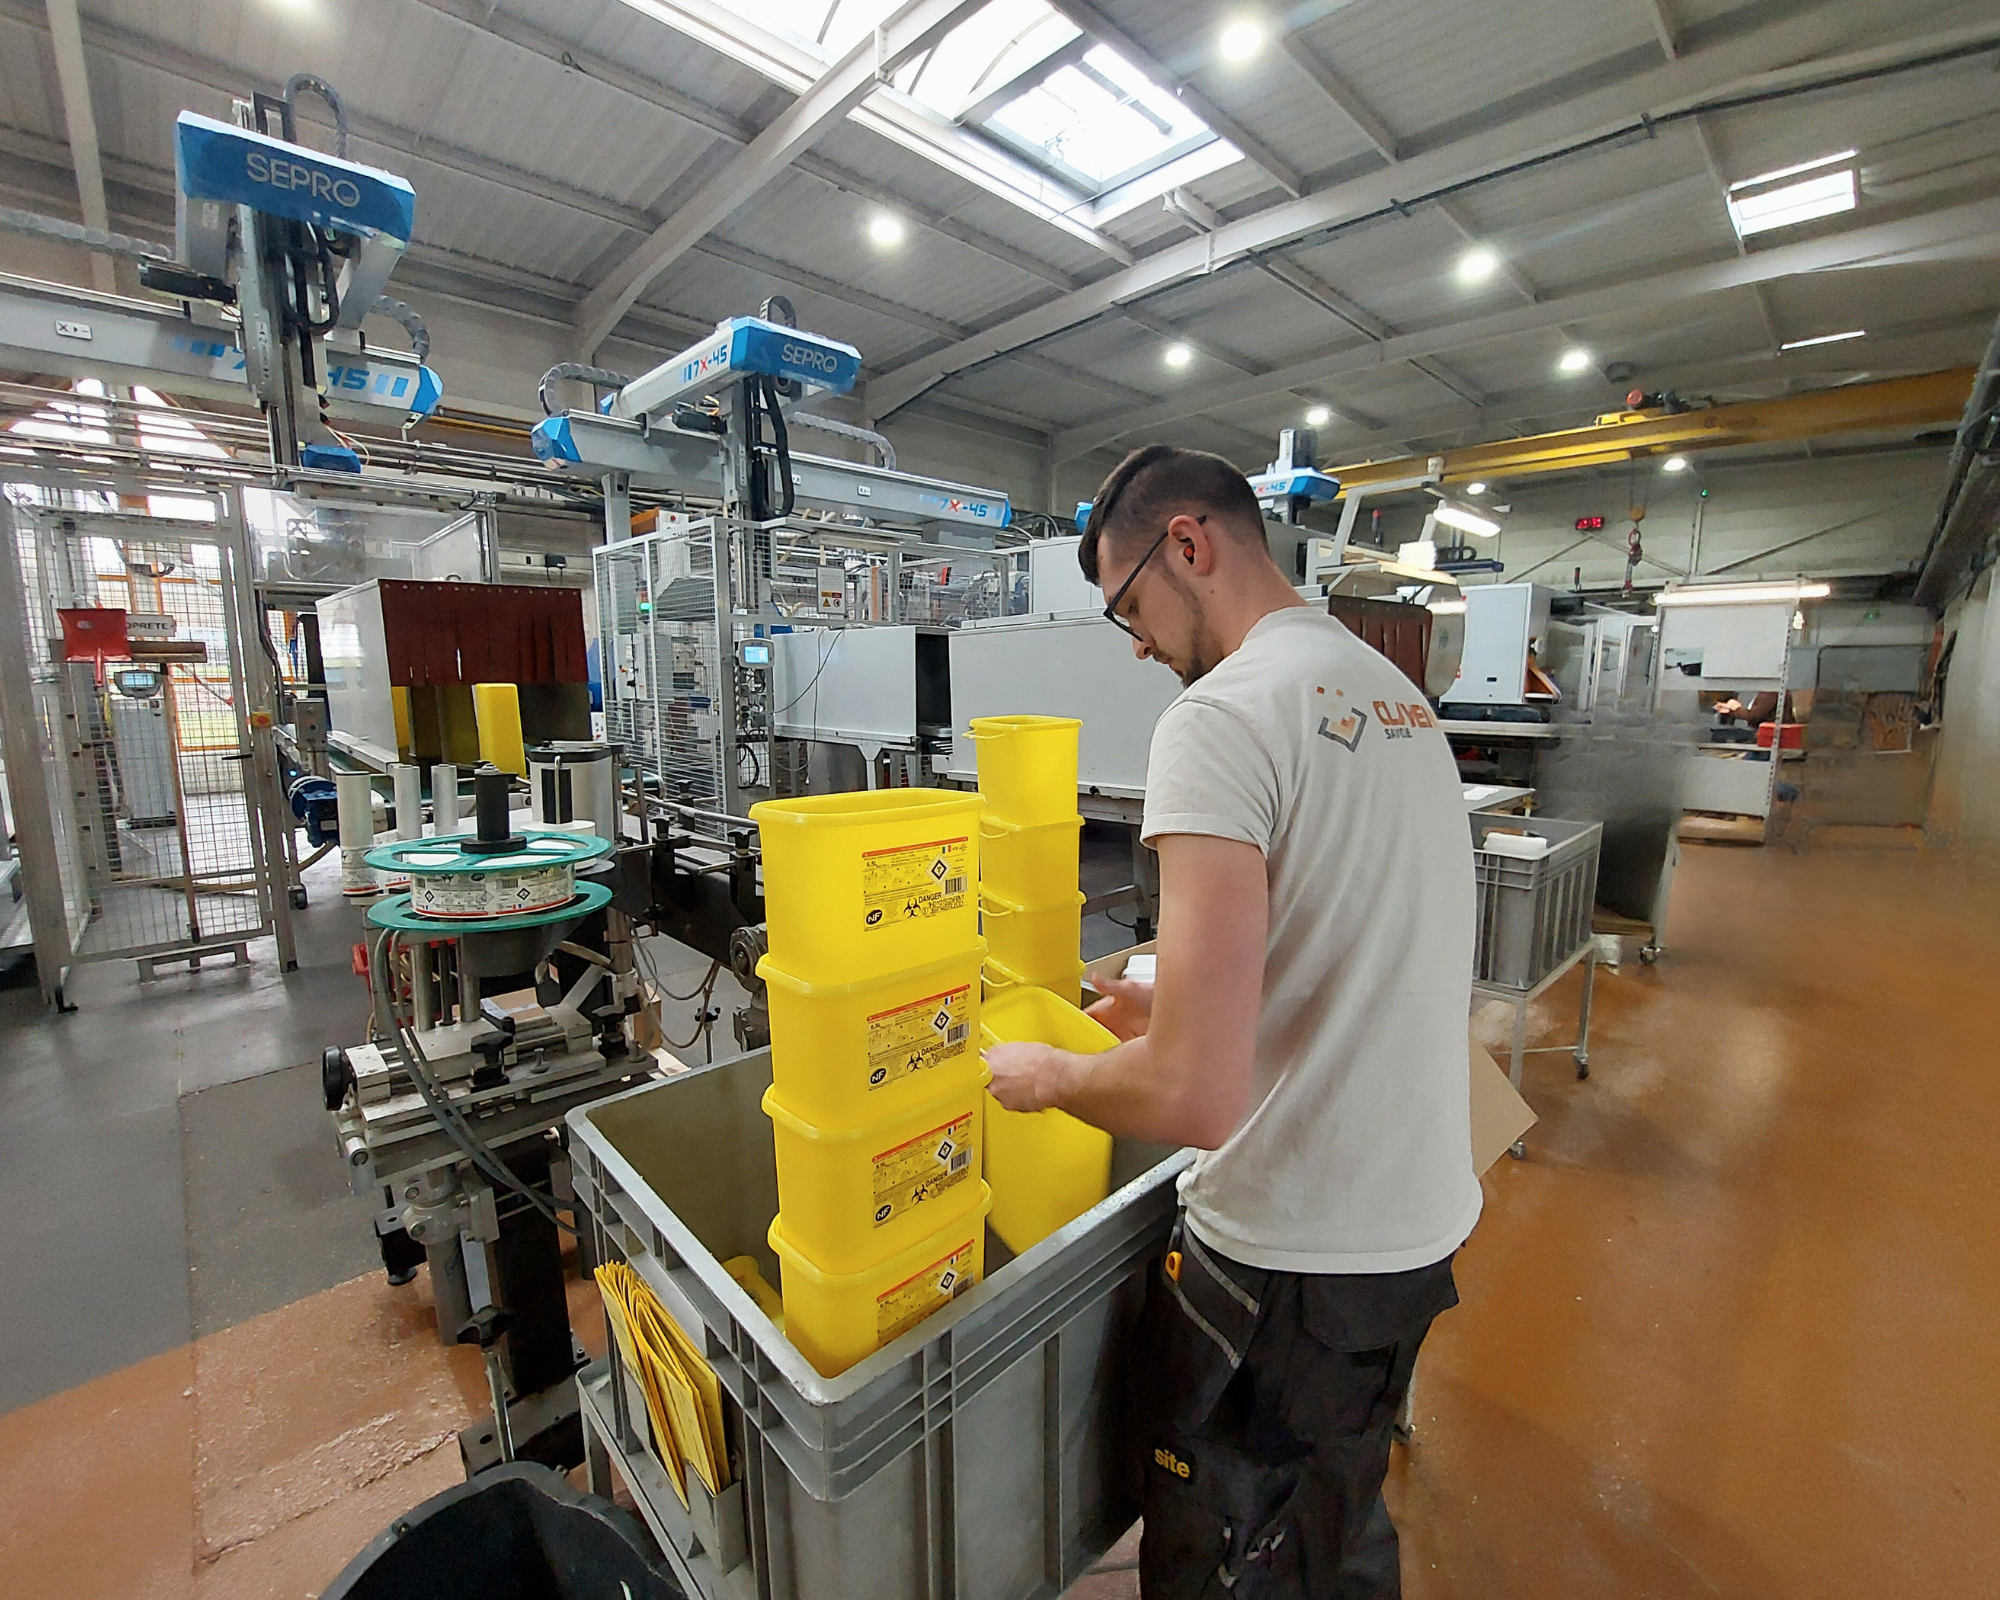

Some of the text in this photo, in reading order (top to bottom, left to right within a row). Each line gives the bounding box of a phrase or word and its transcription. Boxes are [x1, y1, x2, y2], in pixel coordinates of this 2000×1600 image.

[247, 152, 361, 208] SEPRO
[781, 343, 838, 373] SEPRO
[918, 891, 942, 904] DANGER
[867, 910, 882, 924] NF
[921, 1041, 945, 1056] DANGER
[871, 1069, 886, 1083] NF
[876, 1206, 891, 1220] NF
[1154, 1448, 1191, 1479] site
